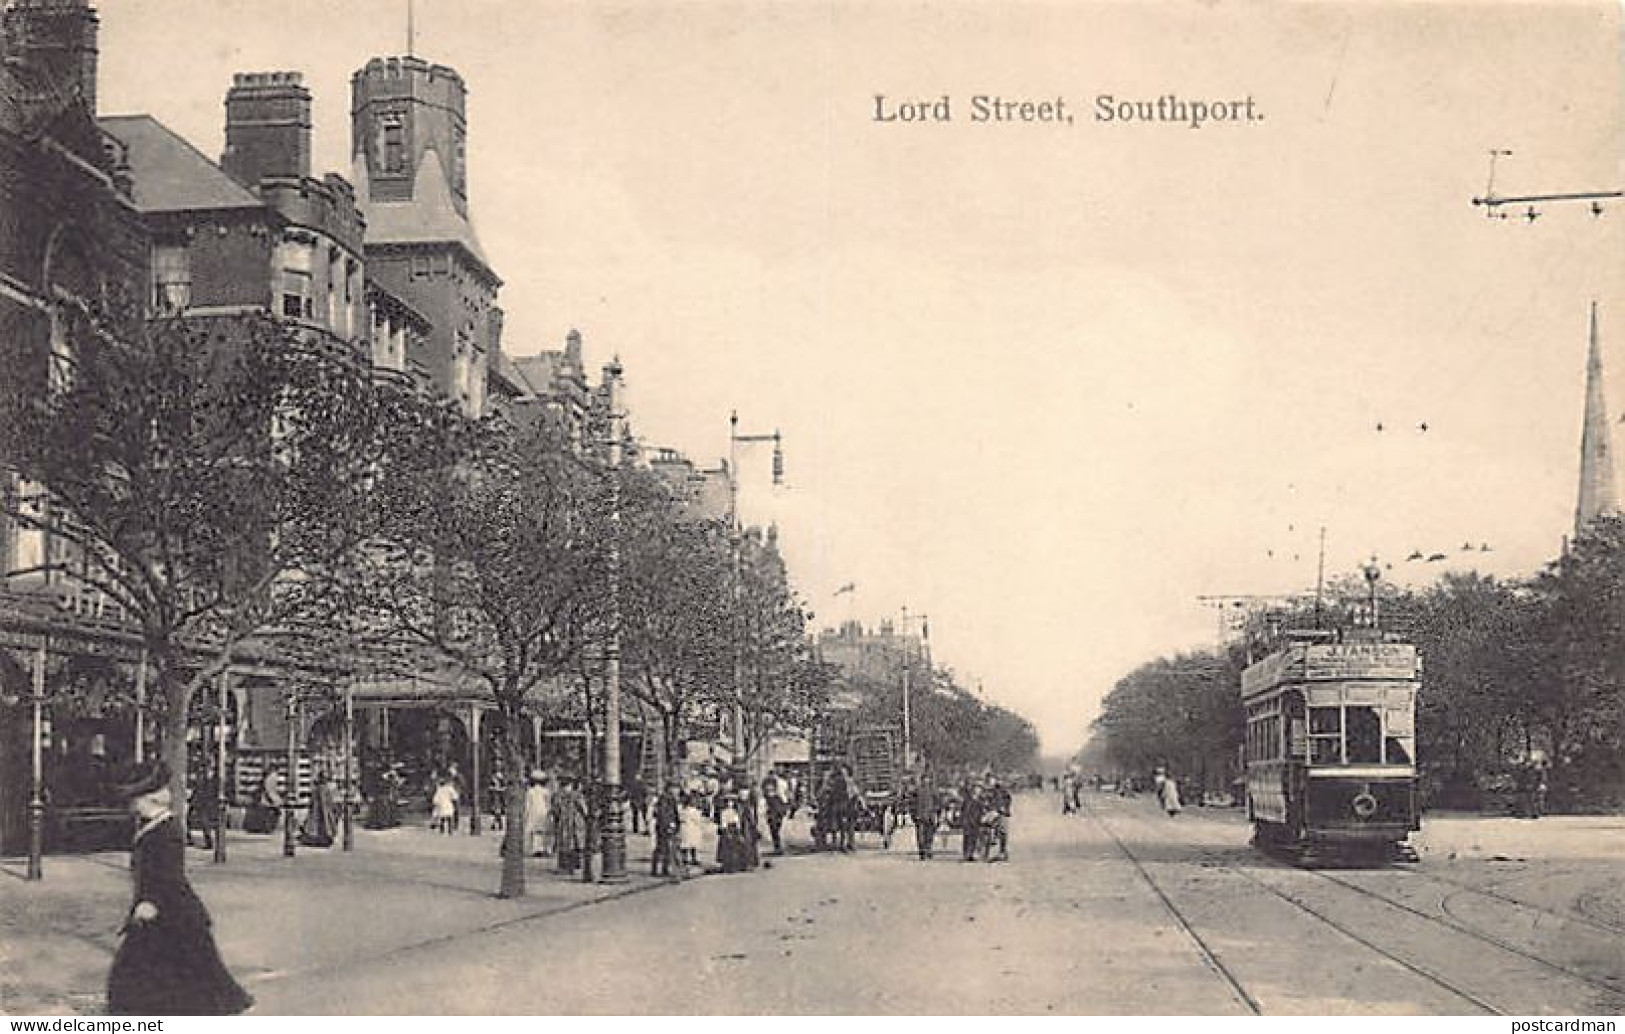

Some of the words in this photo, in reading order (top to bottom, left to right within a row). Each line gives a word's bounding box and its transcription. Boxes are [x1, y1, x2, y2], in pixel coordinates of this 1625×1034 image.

[873, 95, 950, 122] Lord
[970, 95, 1074, 125] Street,
[1095, 95, 1265, 129] Southport.
